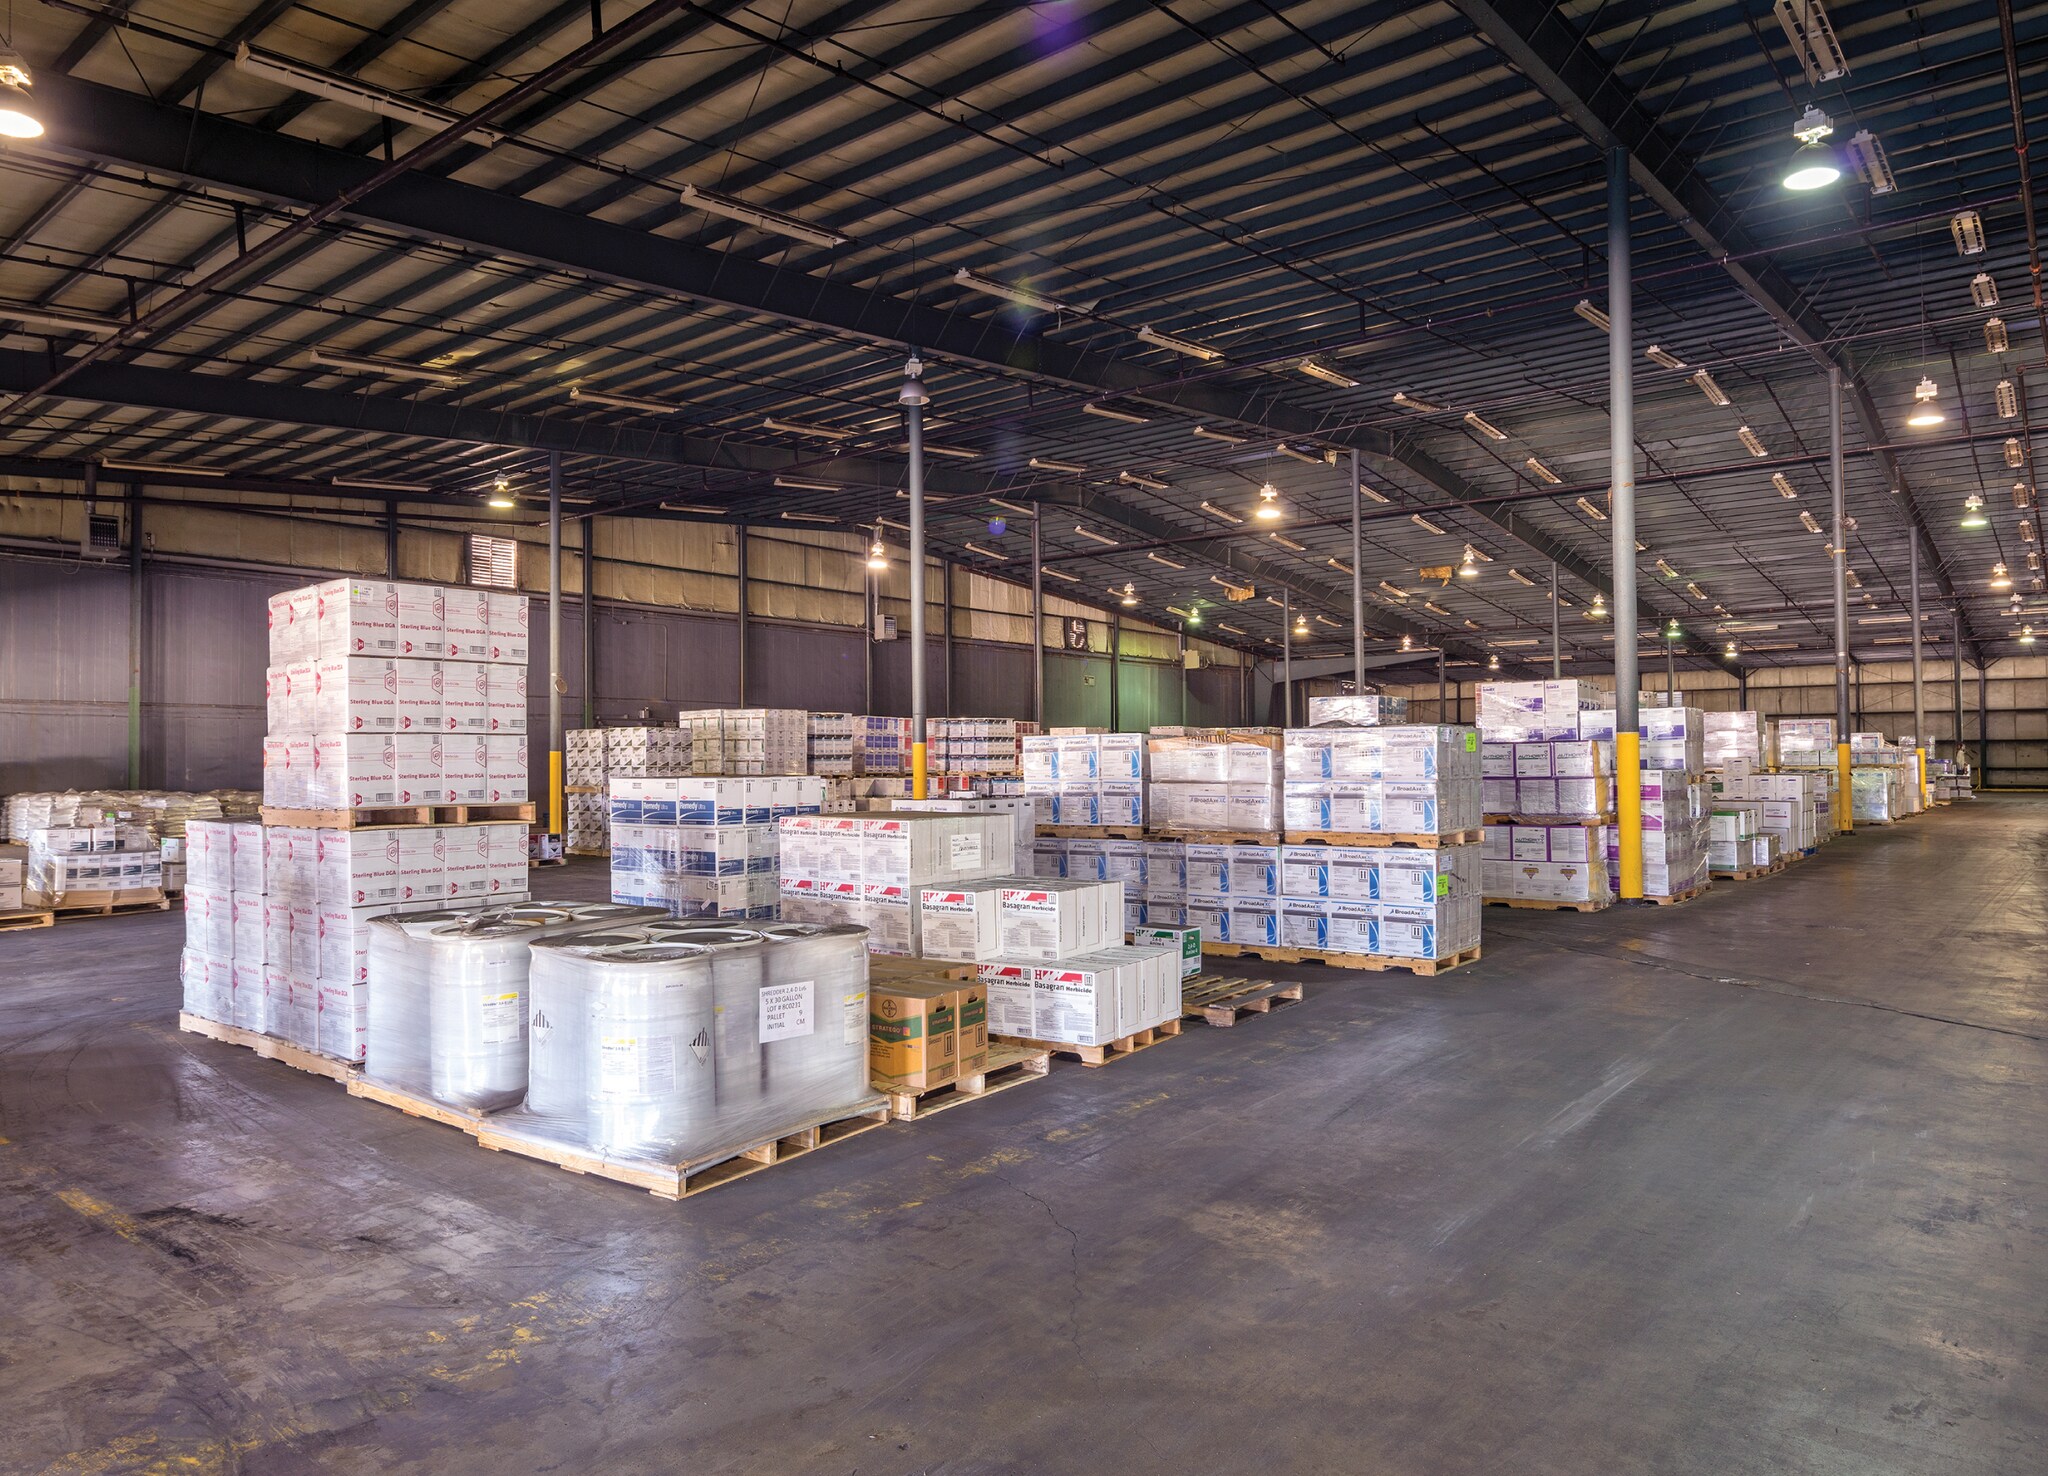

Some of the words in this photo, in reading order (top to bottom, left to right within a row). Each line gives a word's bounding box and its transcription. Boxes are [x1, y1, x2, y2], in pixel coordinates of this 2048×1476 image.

[351, 621, 372, 629] Sterling
[446, 627, 465, 635] Sterling
[611, 801, 627, 809] Remedy
[643, 802, 660, 811] Remedy
[680, 802, 698, 810] Remedy
[780, 828, 799, 836] Basagran
[863, 831, 886, 839] Basagran
[781, 888, 800, 897] Basagran
[820, 891, 841, 900] Basagran
[864, 895, 888, 904] Basagran
[922, 903, 949, 912] Basagran
[1002, 901, 1031, 911] Basagran
[977, 976, 1005, 986] Basagran
[1005, 980, 1031, 988] Herbicide
[1034, 981, 1065, 991] Basagran
[781, 994, 803, 1002] GALLON
[767, 1012, 785, 1020] PALLET
[766, 1022, 785, 1030] INITIAL
[871, 1024, 900, 1034] STRATEGO
